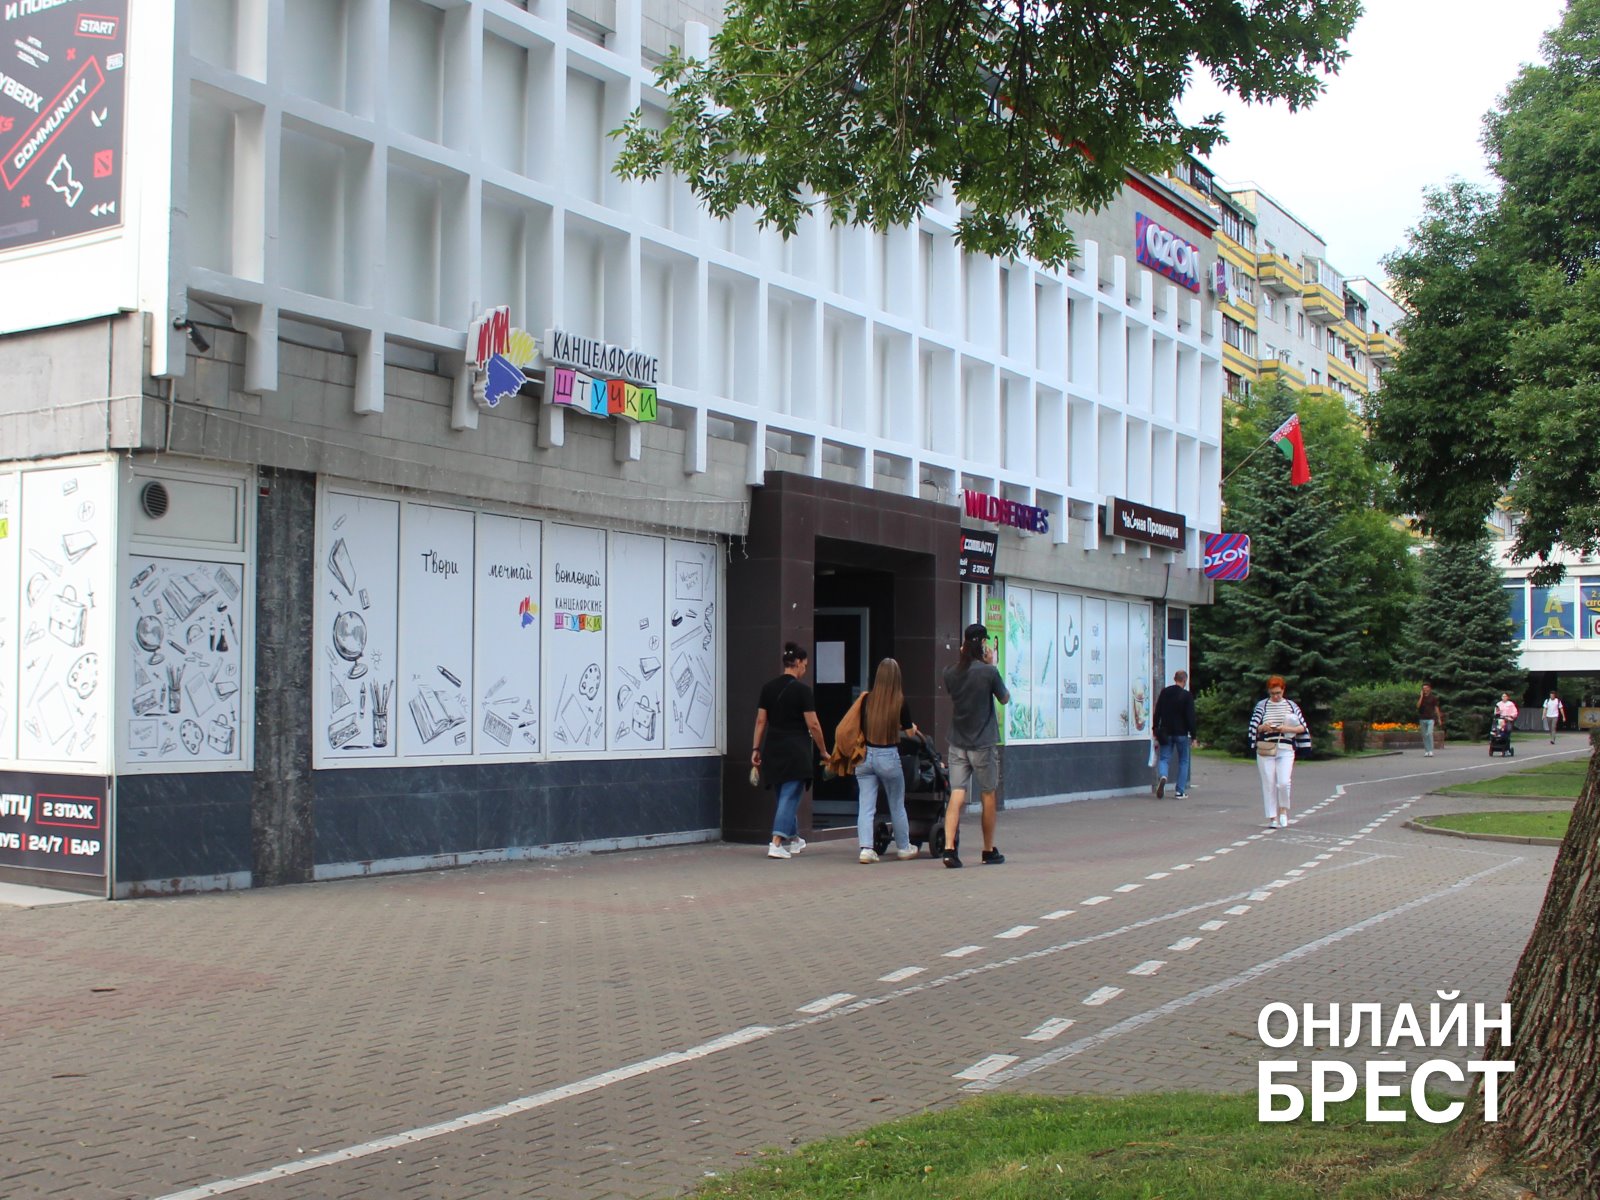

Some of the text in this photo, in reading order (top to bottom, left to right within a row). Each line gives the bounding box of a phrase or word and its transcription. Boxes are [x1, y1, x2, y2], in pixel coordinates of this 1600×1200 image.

[80, 19, 115, 35] START
[13, 78, 88, 169] COMMUNITY
[1146, 223, 1199, 284] OZON
[553, 331, 658, 383] КАНЦЕЛЯРСКИЕ
[556, 373, 655, 418] ШТУЧКИ
[1147, 517, 1178, 540] Провинция
[421, 550, 601, 589] Твори мечтай воплощай
[555, 597, 602, 613] КАНЦЕЛЯРСКИЕ
[555, 614, 601, 629] ШТУЧКИ
[43, 802, 93, 819] 2 ЭТАЖ
[28, 835, 63, 853] 24/7
[70, 838, 100, 856] БАР
